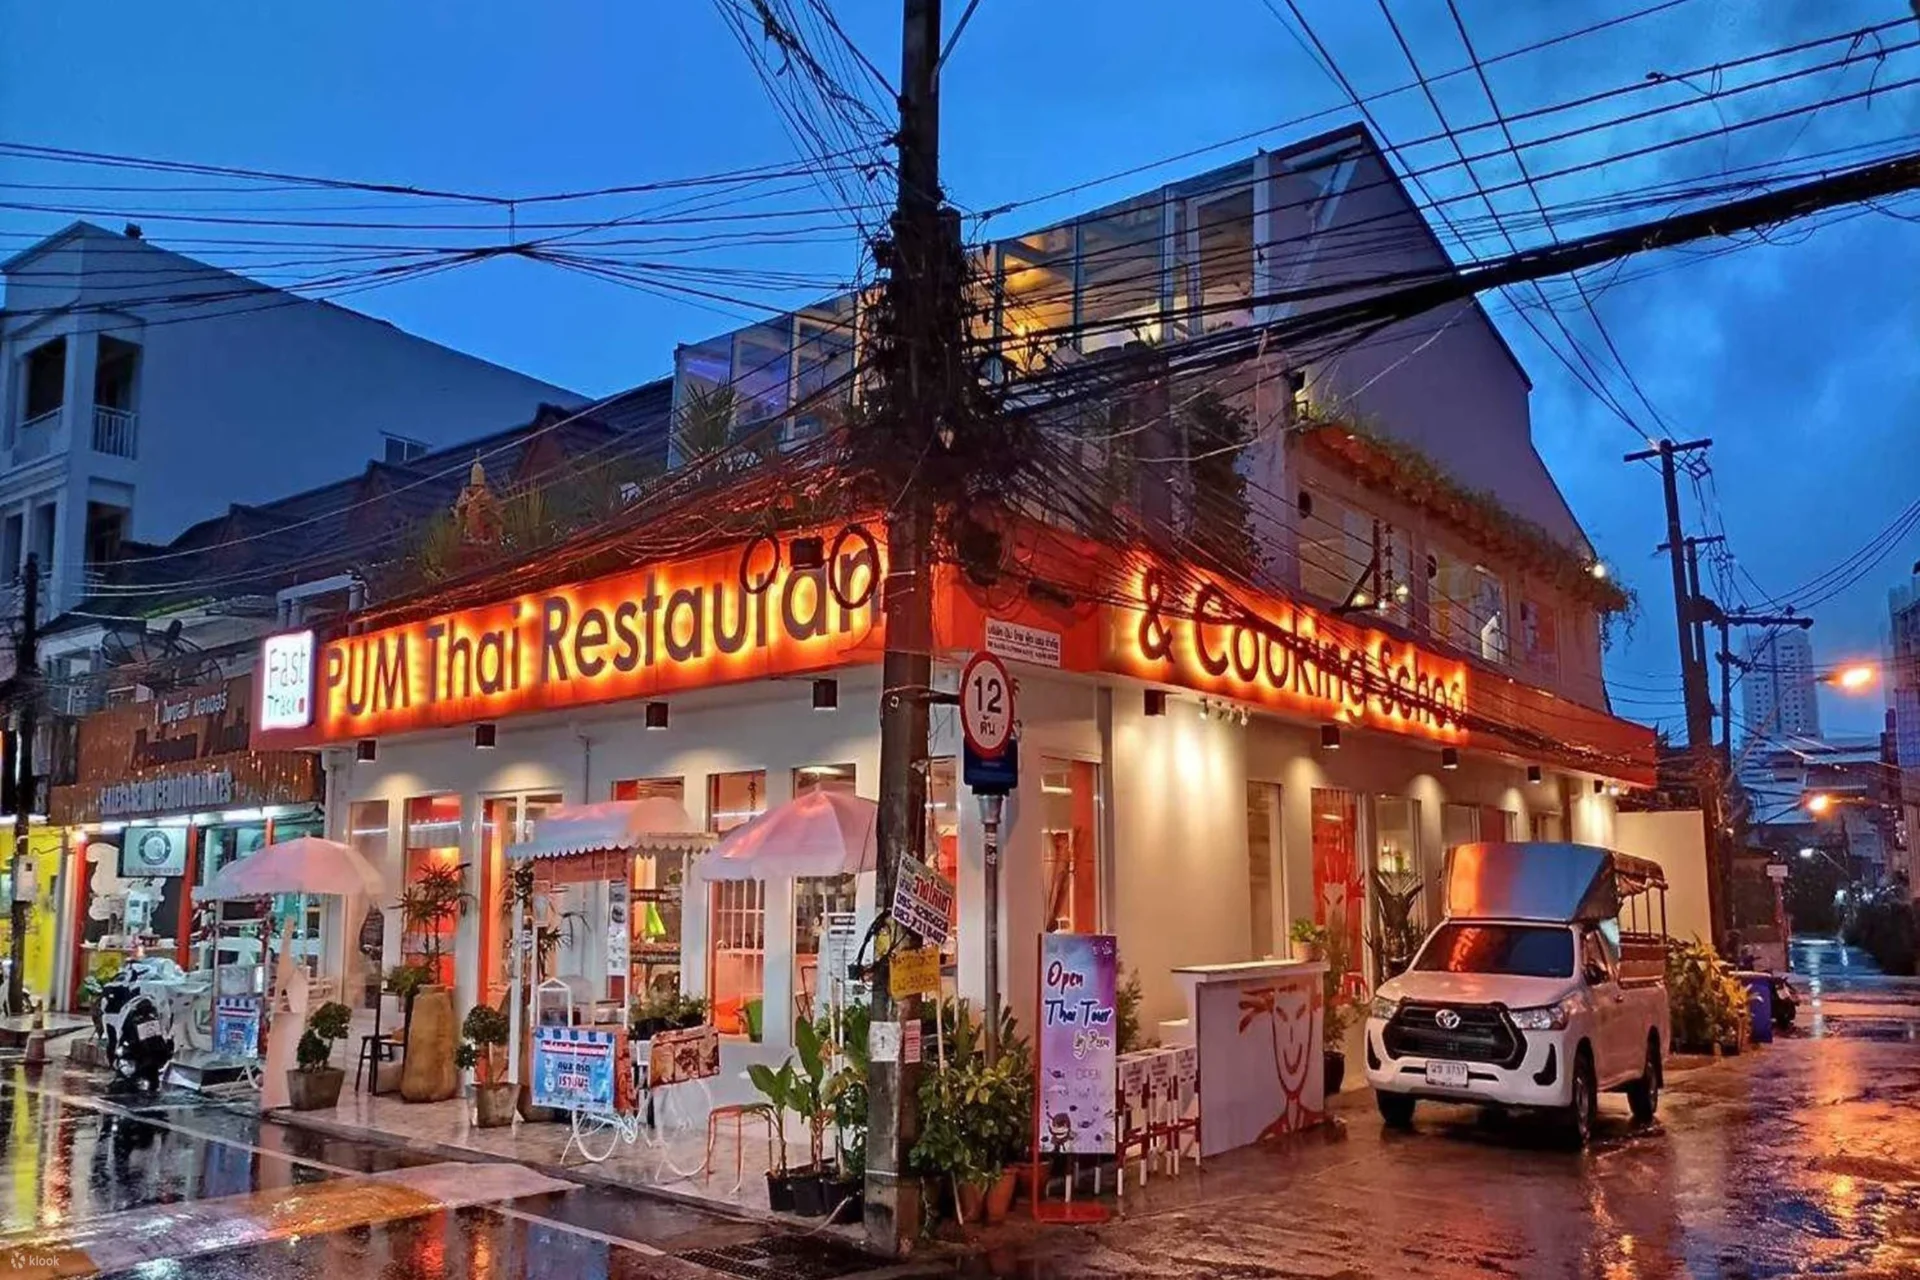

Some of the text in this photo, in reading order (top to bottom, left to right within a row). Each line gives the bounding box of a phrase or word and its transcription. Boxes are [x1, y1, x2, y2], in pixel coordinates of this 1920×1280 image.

[326, 548, 881, 716] PUM Thai Restauran
[1138, 568, 1467, 730] & Cooking Scho
[269, 647, 306, 688] Fast
[974, 676, 1002, 714] 12
[980, 715, 996, 736] ตัน
[1047, 961, 1084, 995] Open
[1045, 1000, 1112, 1028] Thai Tour
